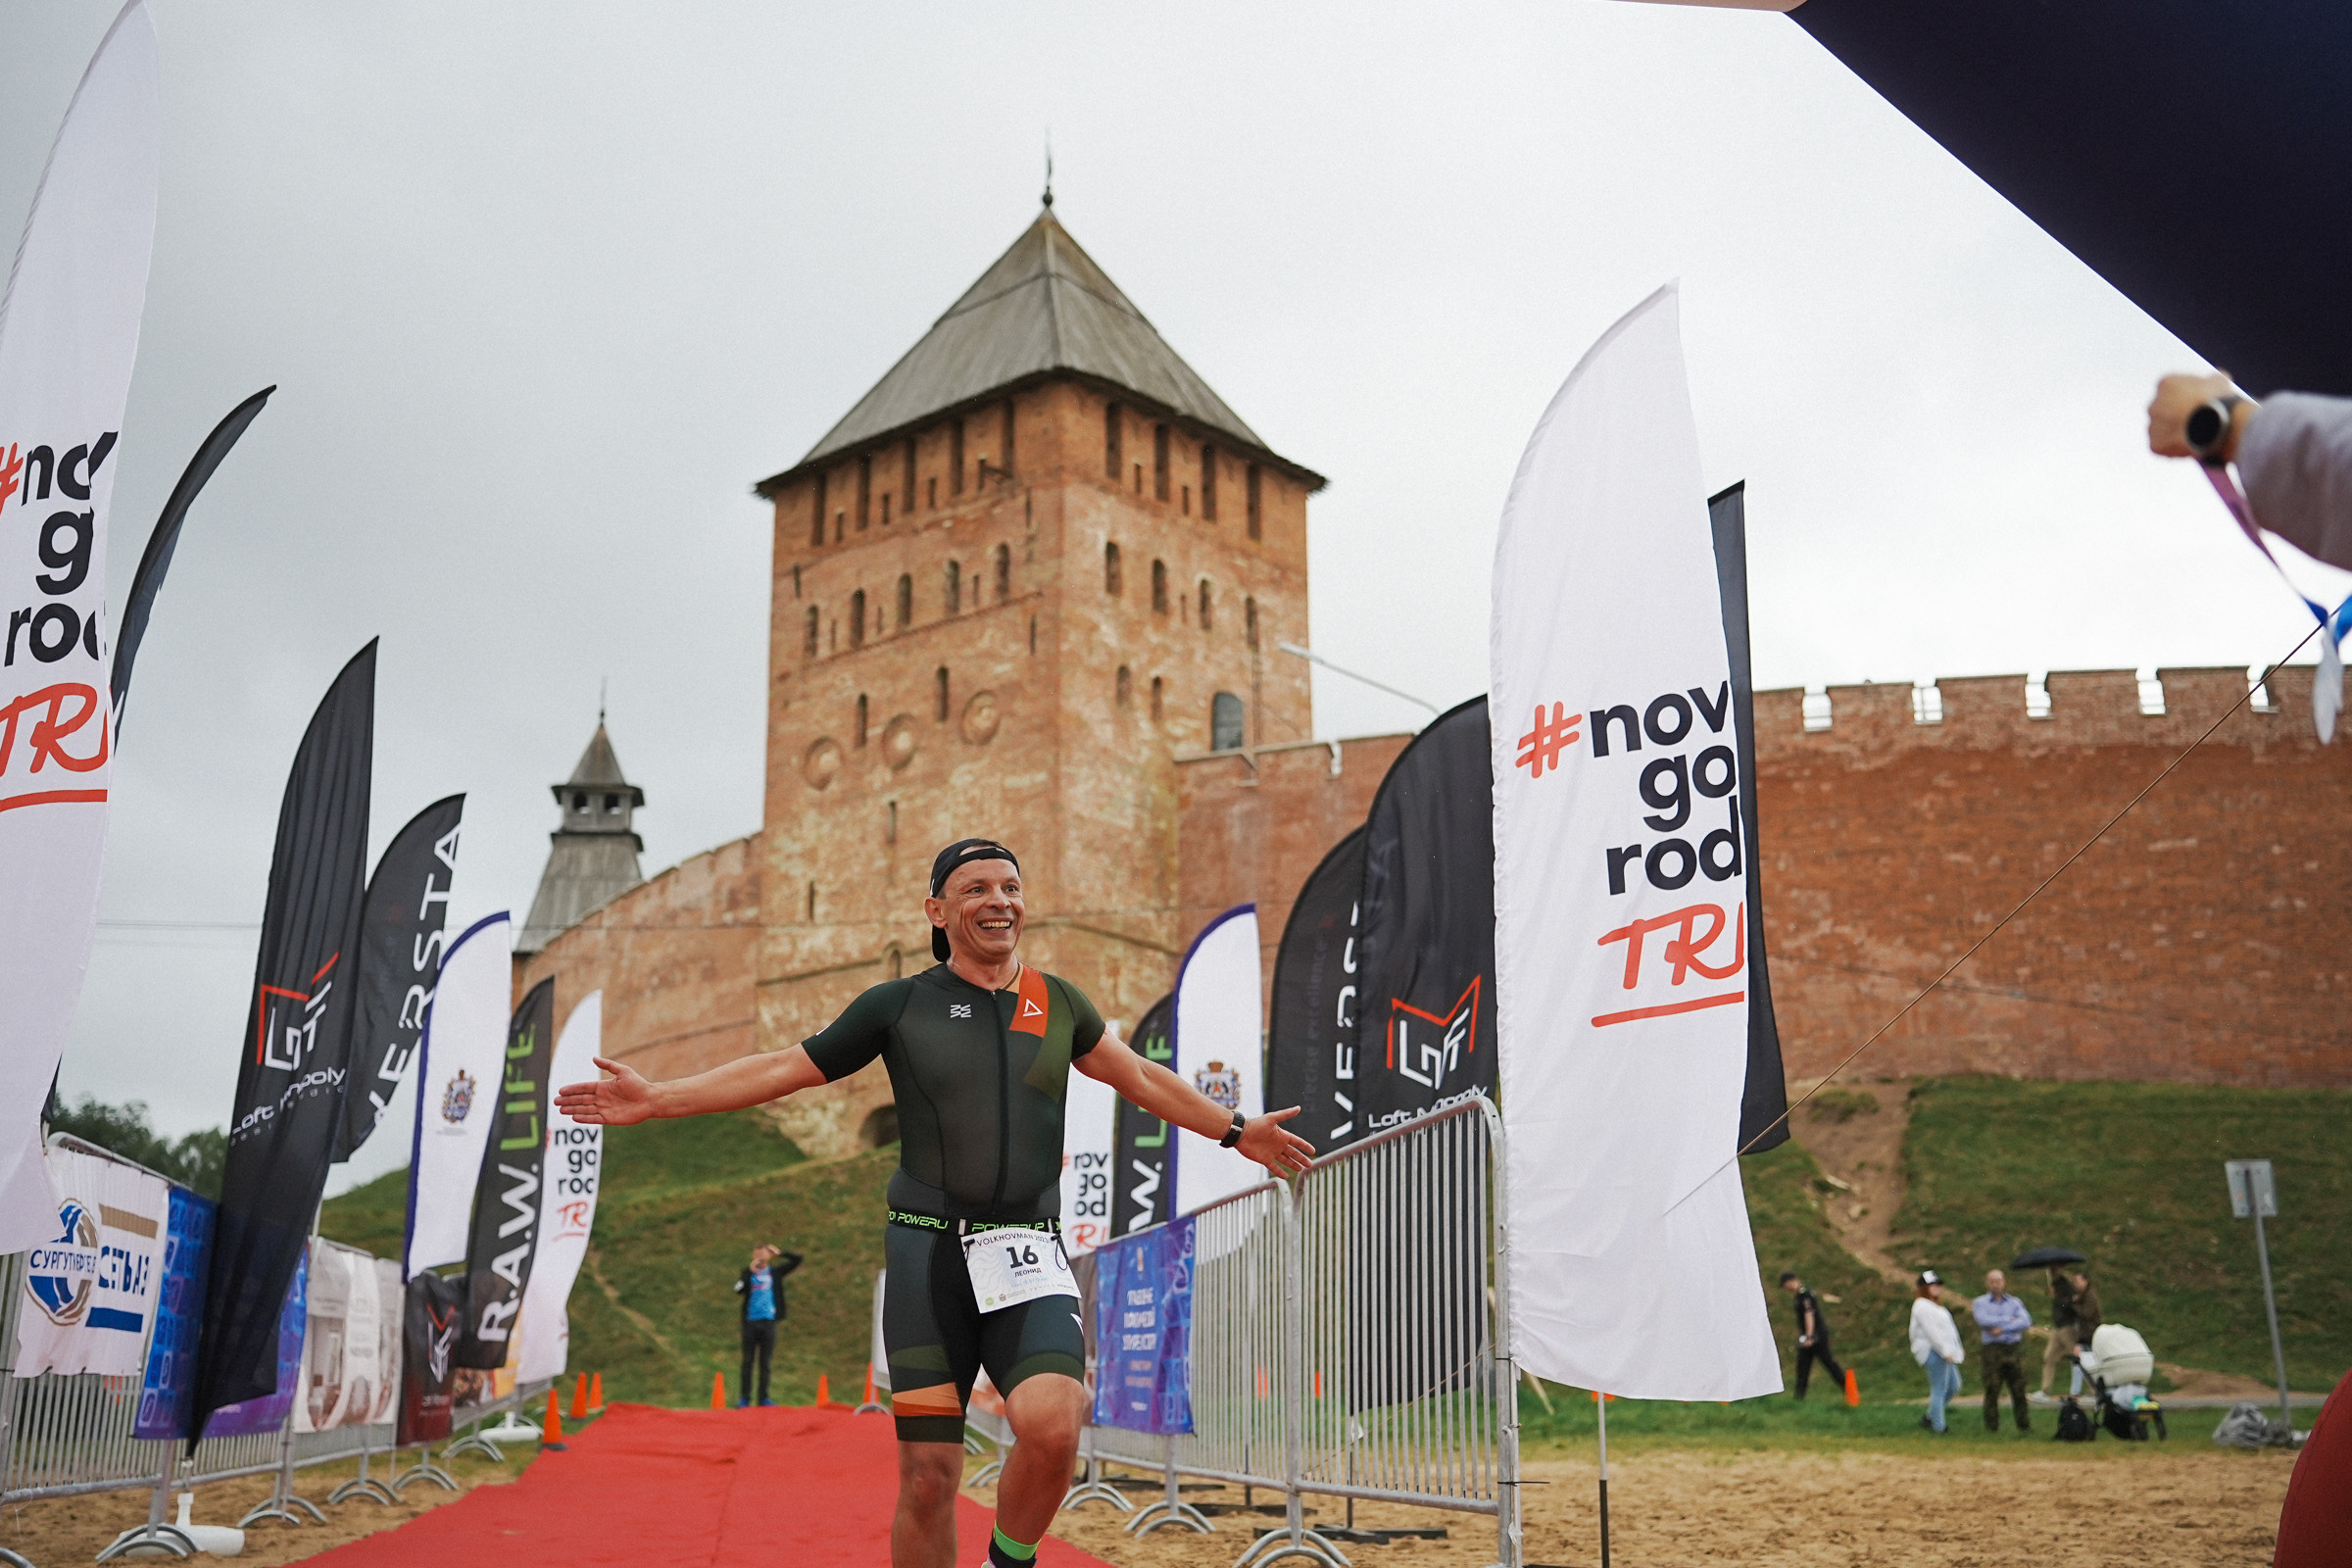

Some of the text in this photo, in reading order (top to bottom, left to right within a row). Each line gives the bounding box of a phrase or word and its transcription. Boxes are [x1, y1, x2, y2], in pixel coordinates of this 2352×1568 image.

[1639, 745, 1737, 832] go
[1606, 795, 1742, 896] rod
[1005, 1245, 1040, 1269] 16
[1014, 1268, 1042, 1278] ЛЕОНИД
